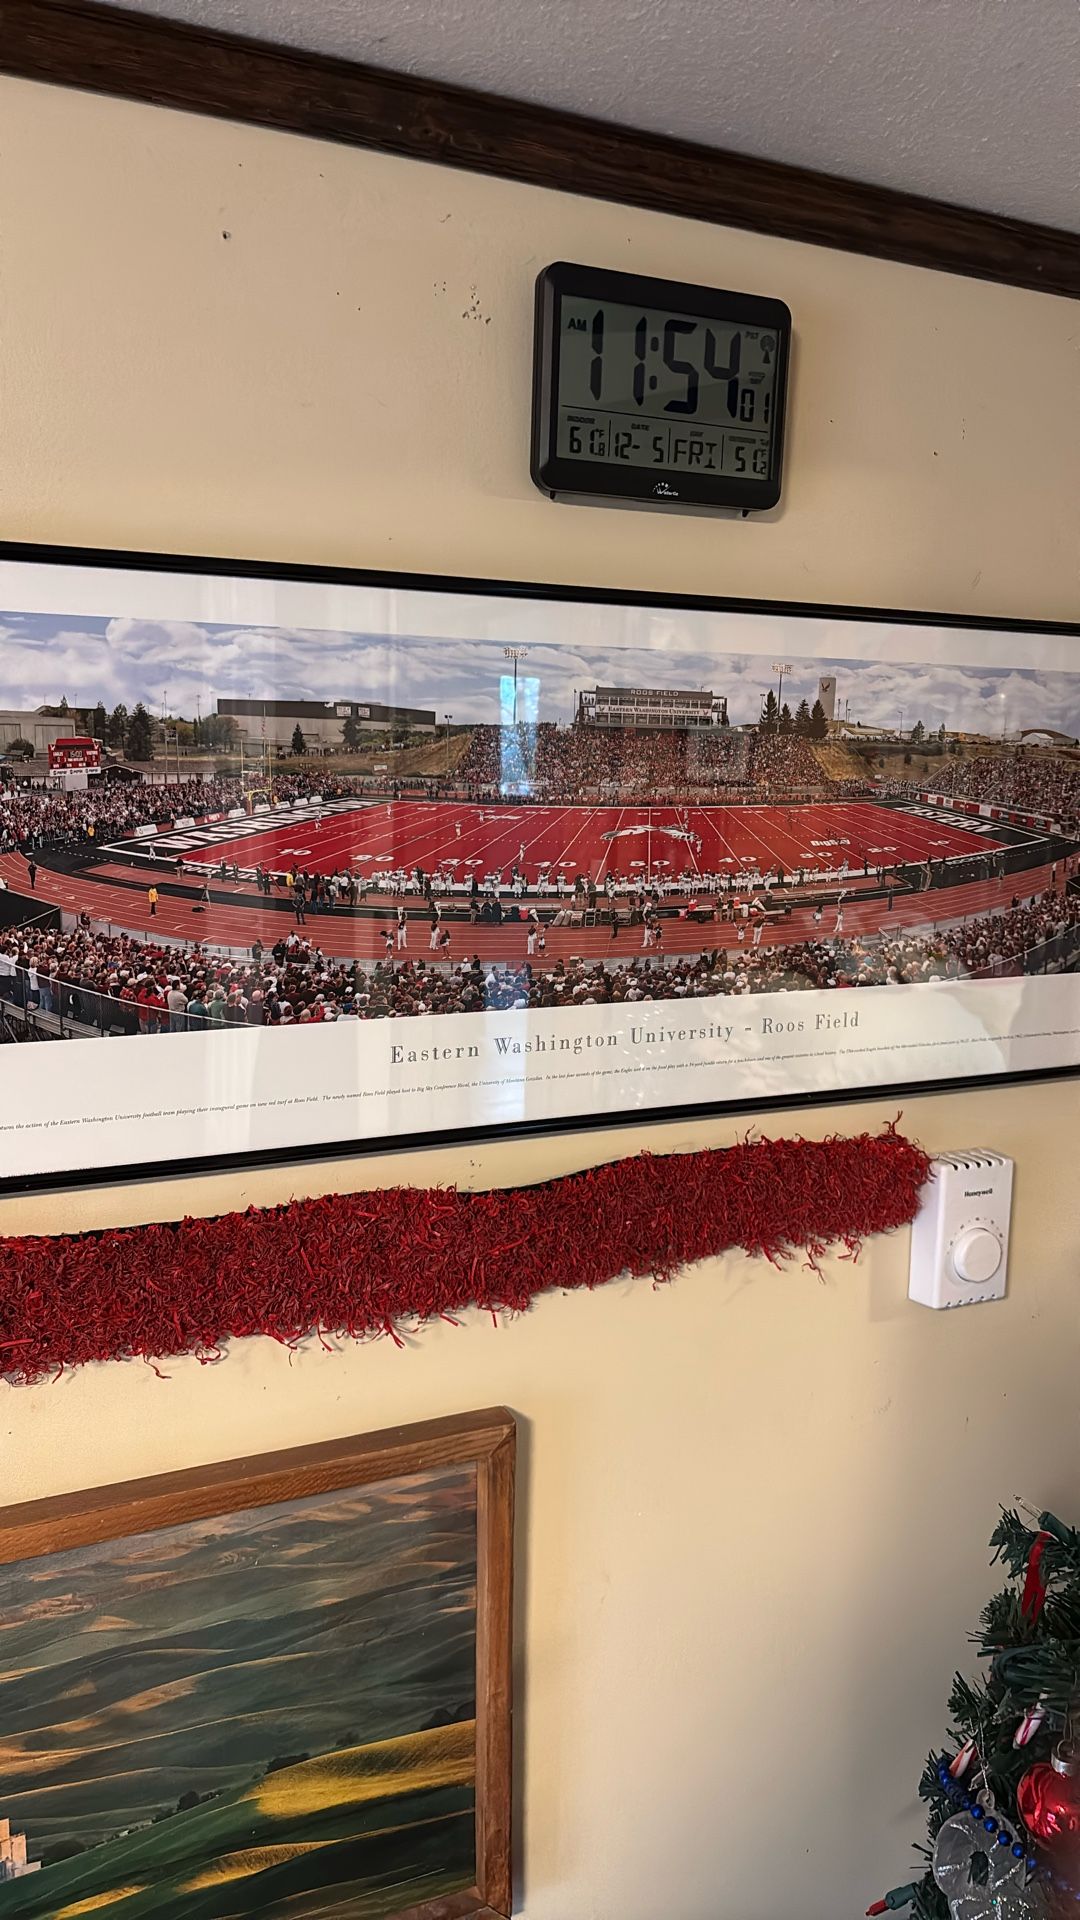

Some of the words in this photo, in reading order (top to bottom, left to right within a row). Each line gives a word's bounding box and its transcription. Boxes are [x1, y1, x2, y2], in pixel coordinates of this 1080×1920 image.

[568, 318, 587, 332] AM
[590, 310, 741, 418] 11:54
[674, 439, 718, 469] FRI
[390, 1045, 480, 1064] Eastern
[493, 1034, 618, 1055] Washington
[631, 1022, 734, 1044] University
[762, 1017, 804, 1034] Roos
[815, 1011, 859, 1030] Field
[964, 1188, 993, 1197] Honeywell
